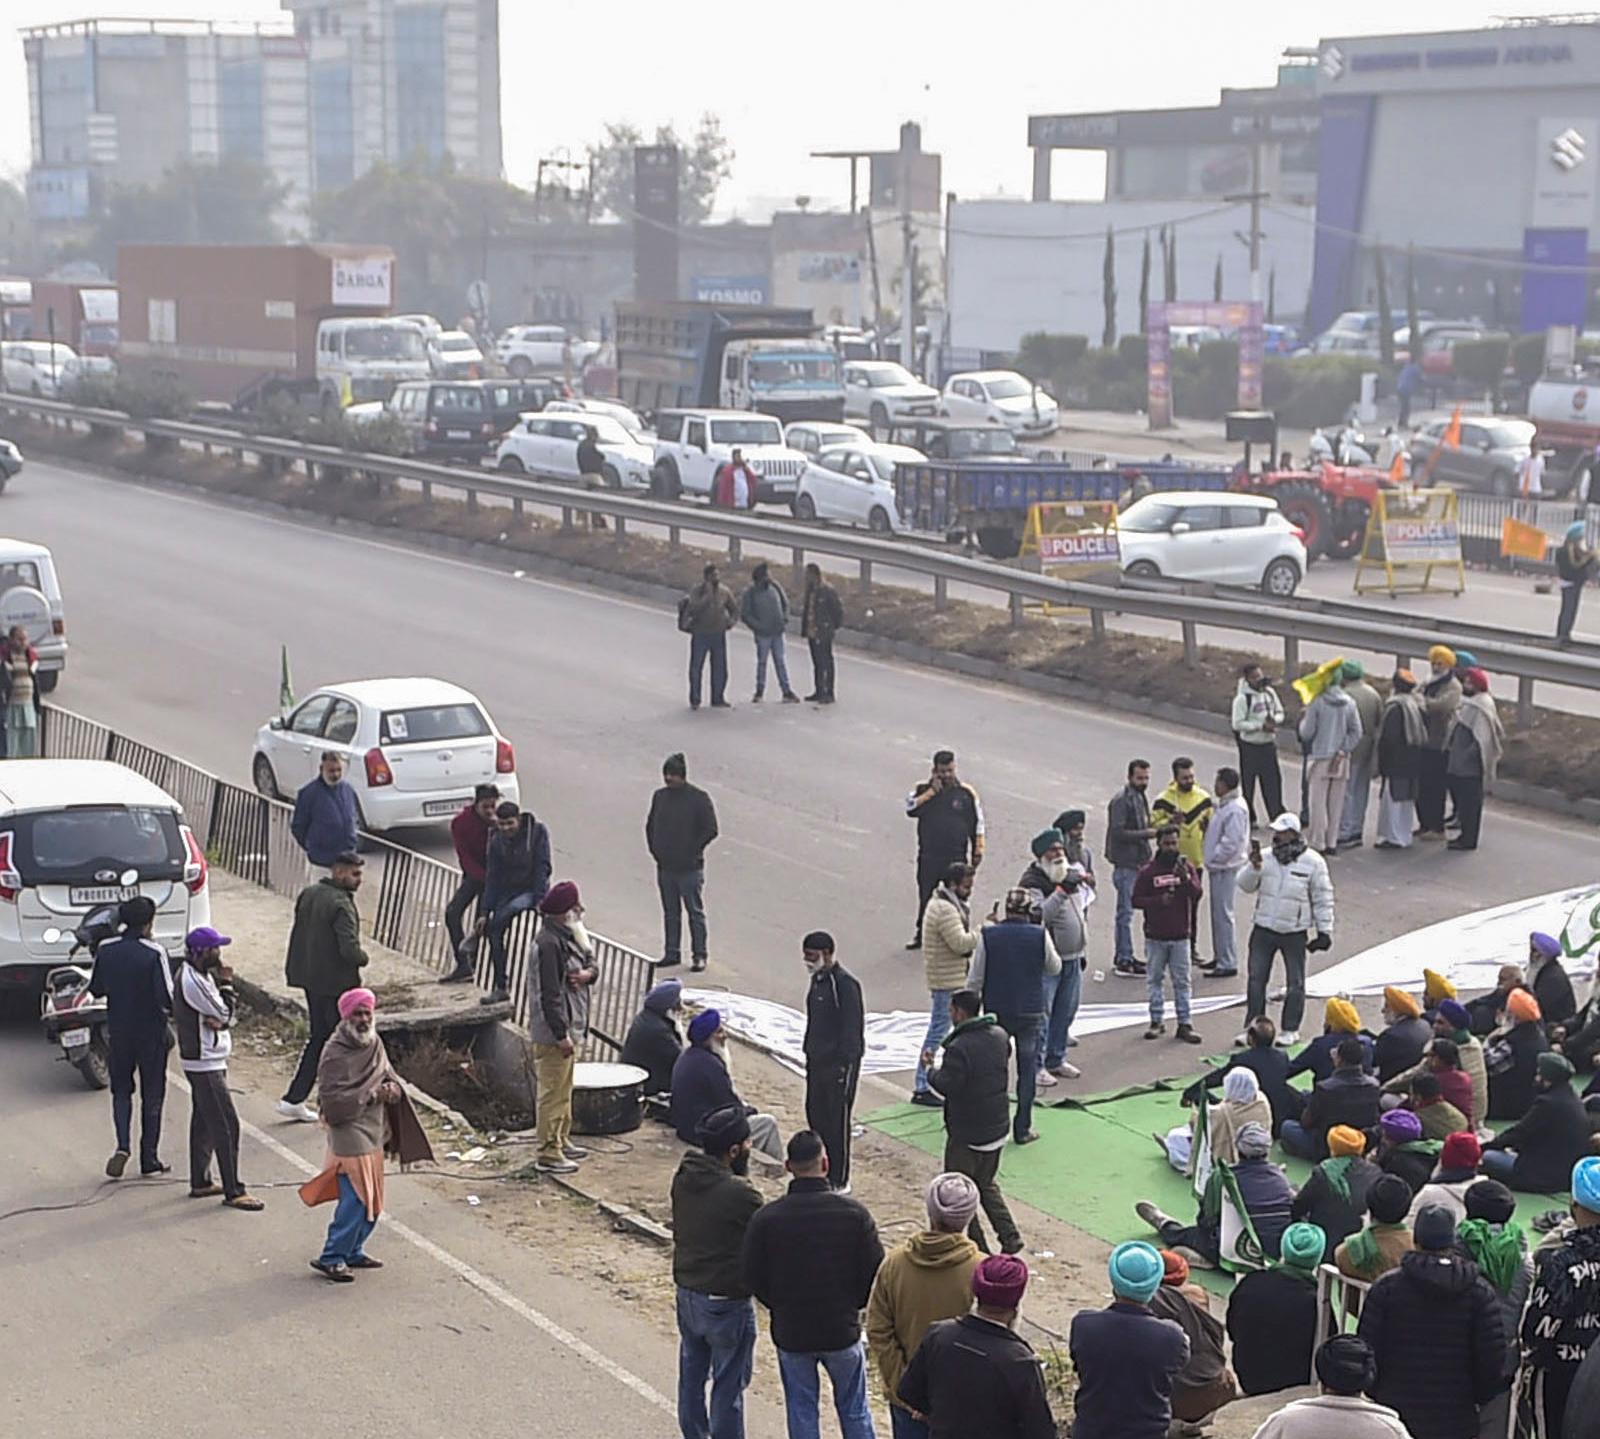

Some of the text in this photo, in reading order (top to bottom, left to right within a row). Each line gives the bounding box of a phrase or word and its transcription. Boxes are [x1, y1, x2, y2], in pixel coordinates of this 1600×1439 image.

[697, 289, 764, 304] KOSMO
[1399, 520, 1445, 540] POLICE
[1052, 538, 1106, 555] POLICE
